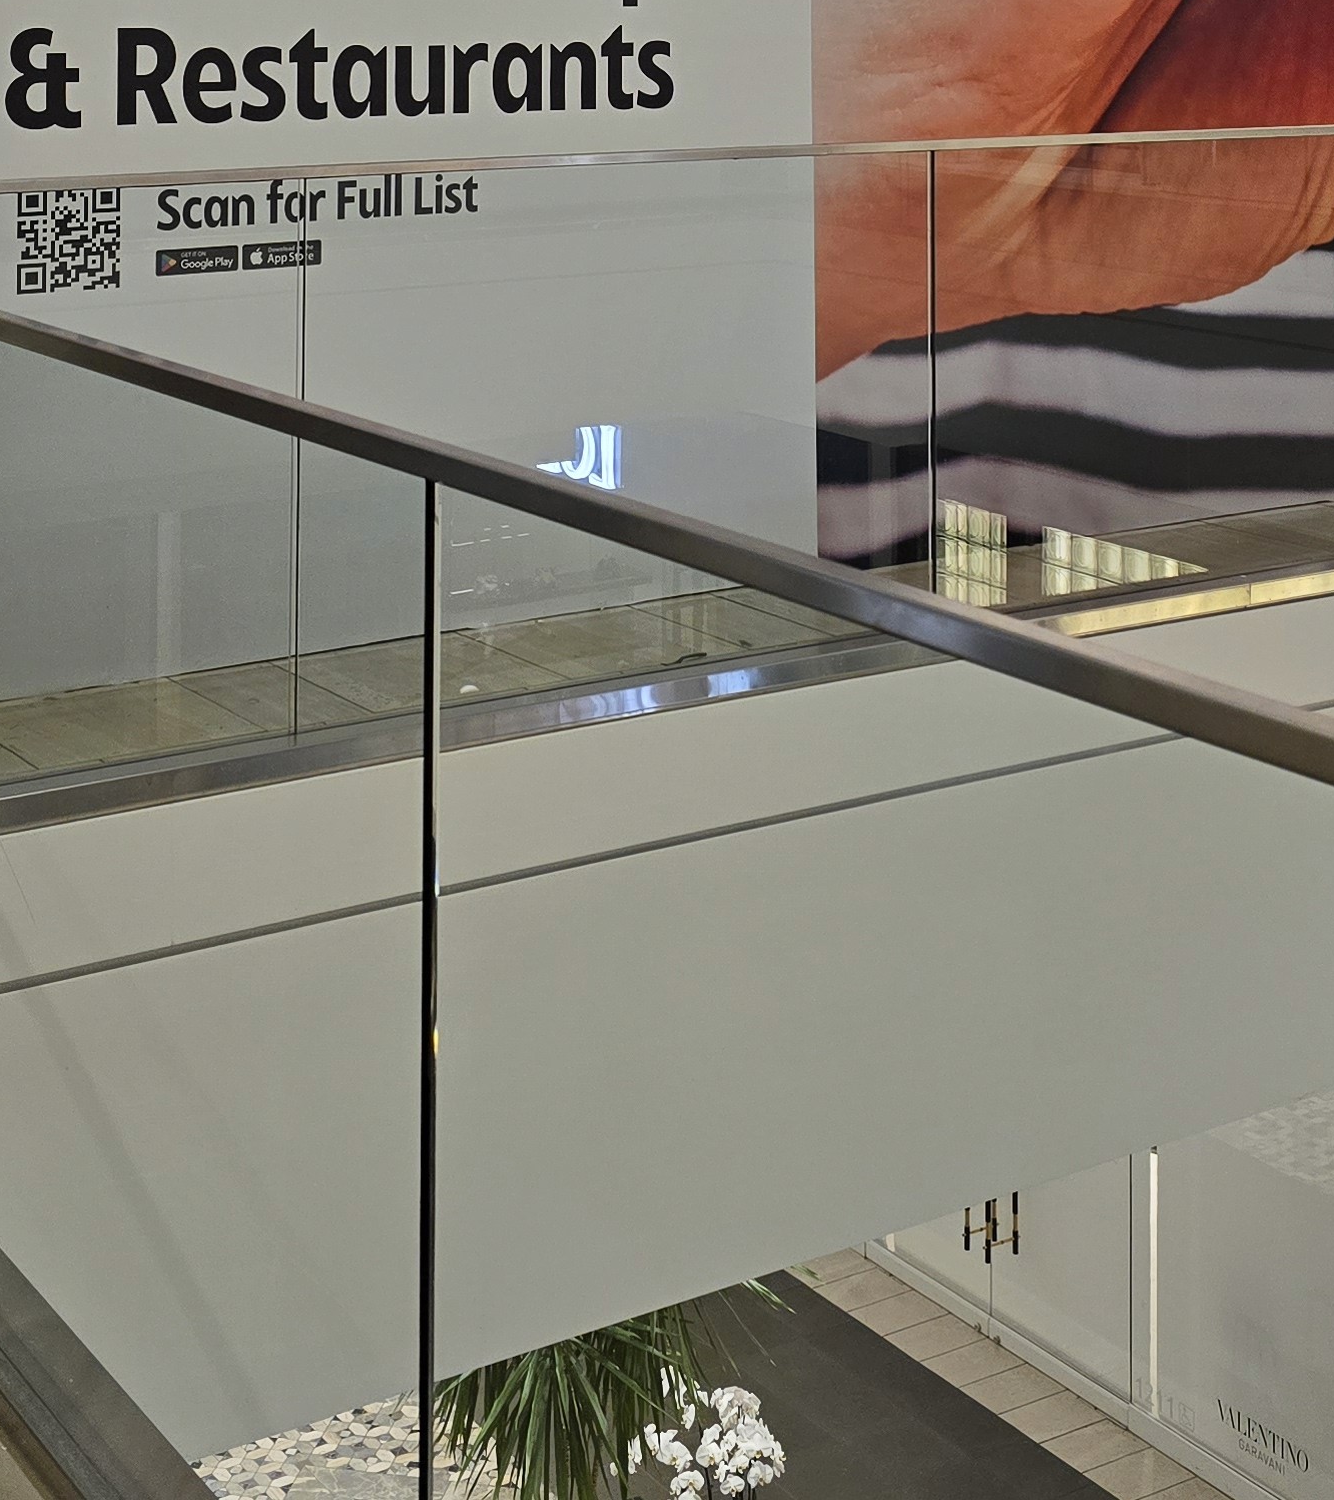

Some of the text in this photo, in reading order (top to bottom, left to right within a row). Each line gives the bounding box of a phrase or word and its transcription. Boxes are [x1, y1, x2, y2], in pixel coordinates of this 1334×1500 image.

[5, 24, 674, 130] & Restaurants
[156, 174, 479, 231] Scan for Full List
[180, 256, 234, 271] Google Play
[267, 253, 288, 265] App
[1217, 1399, 1309, 1473] VALENTINO
[1238, 1437, 1286, 1476] GARAVANI
